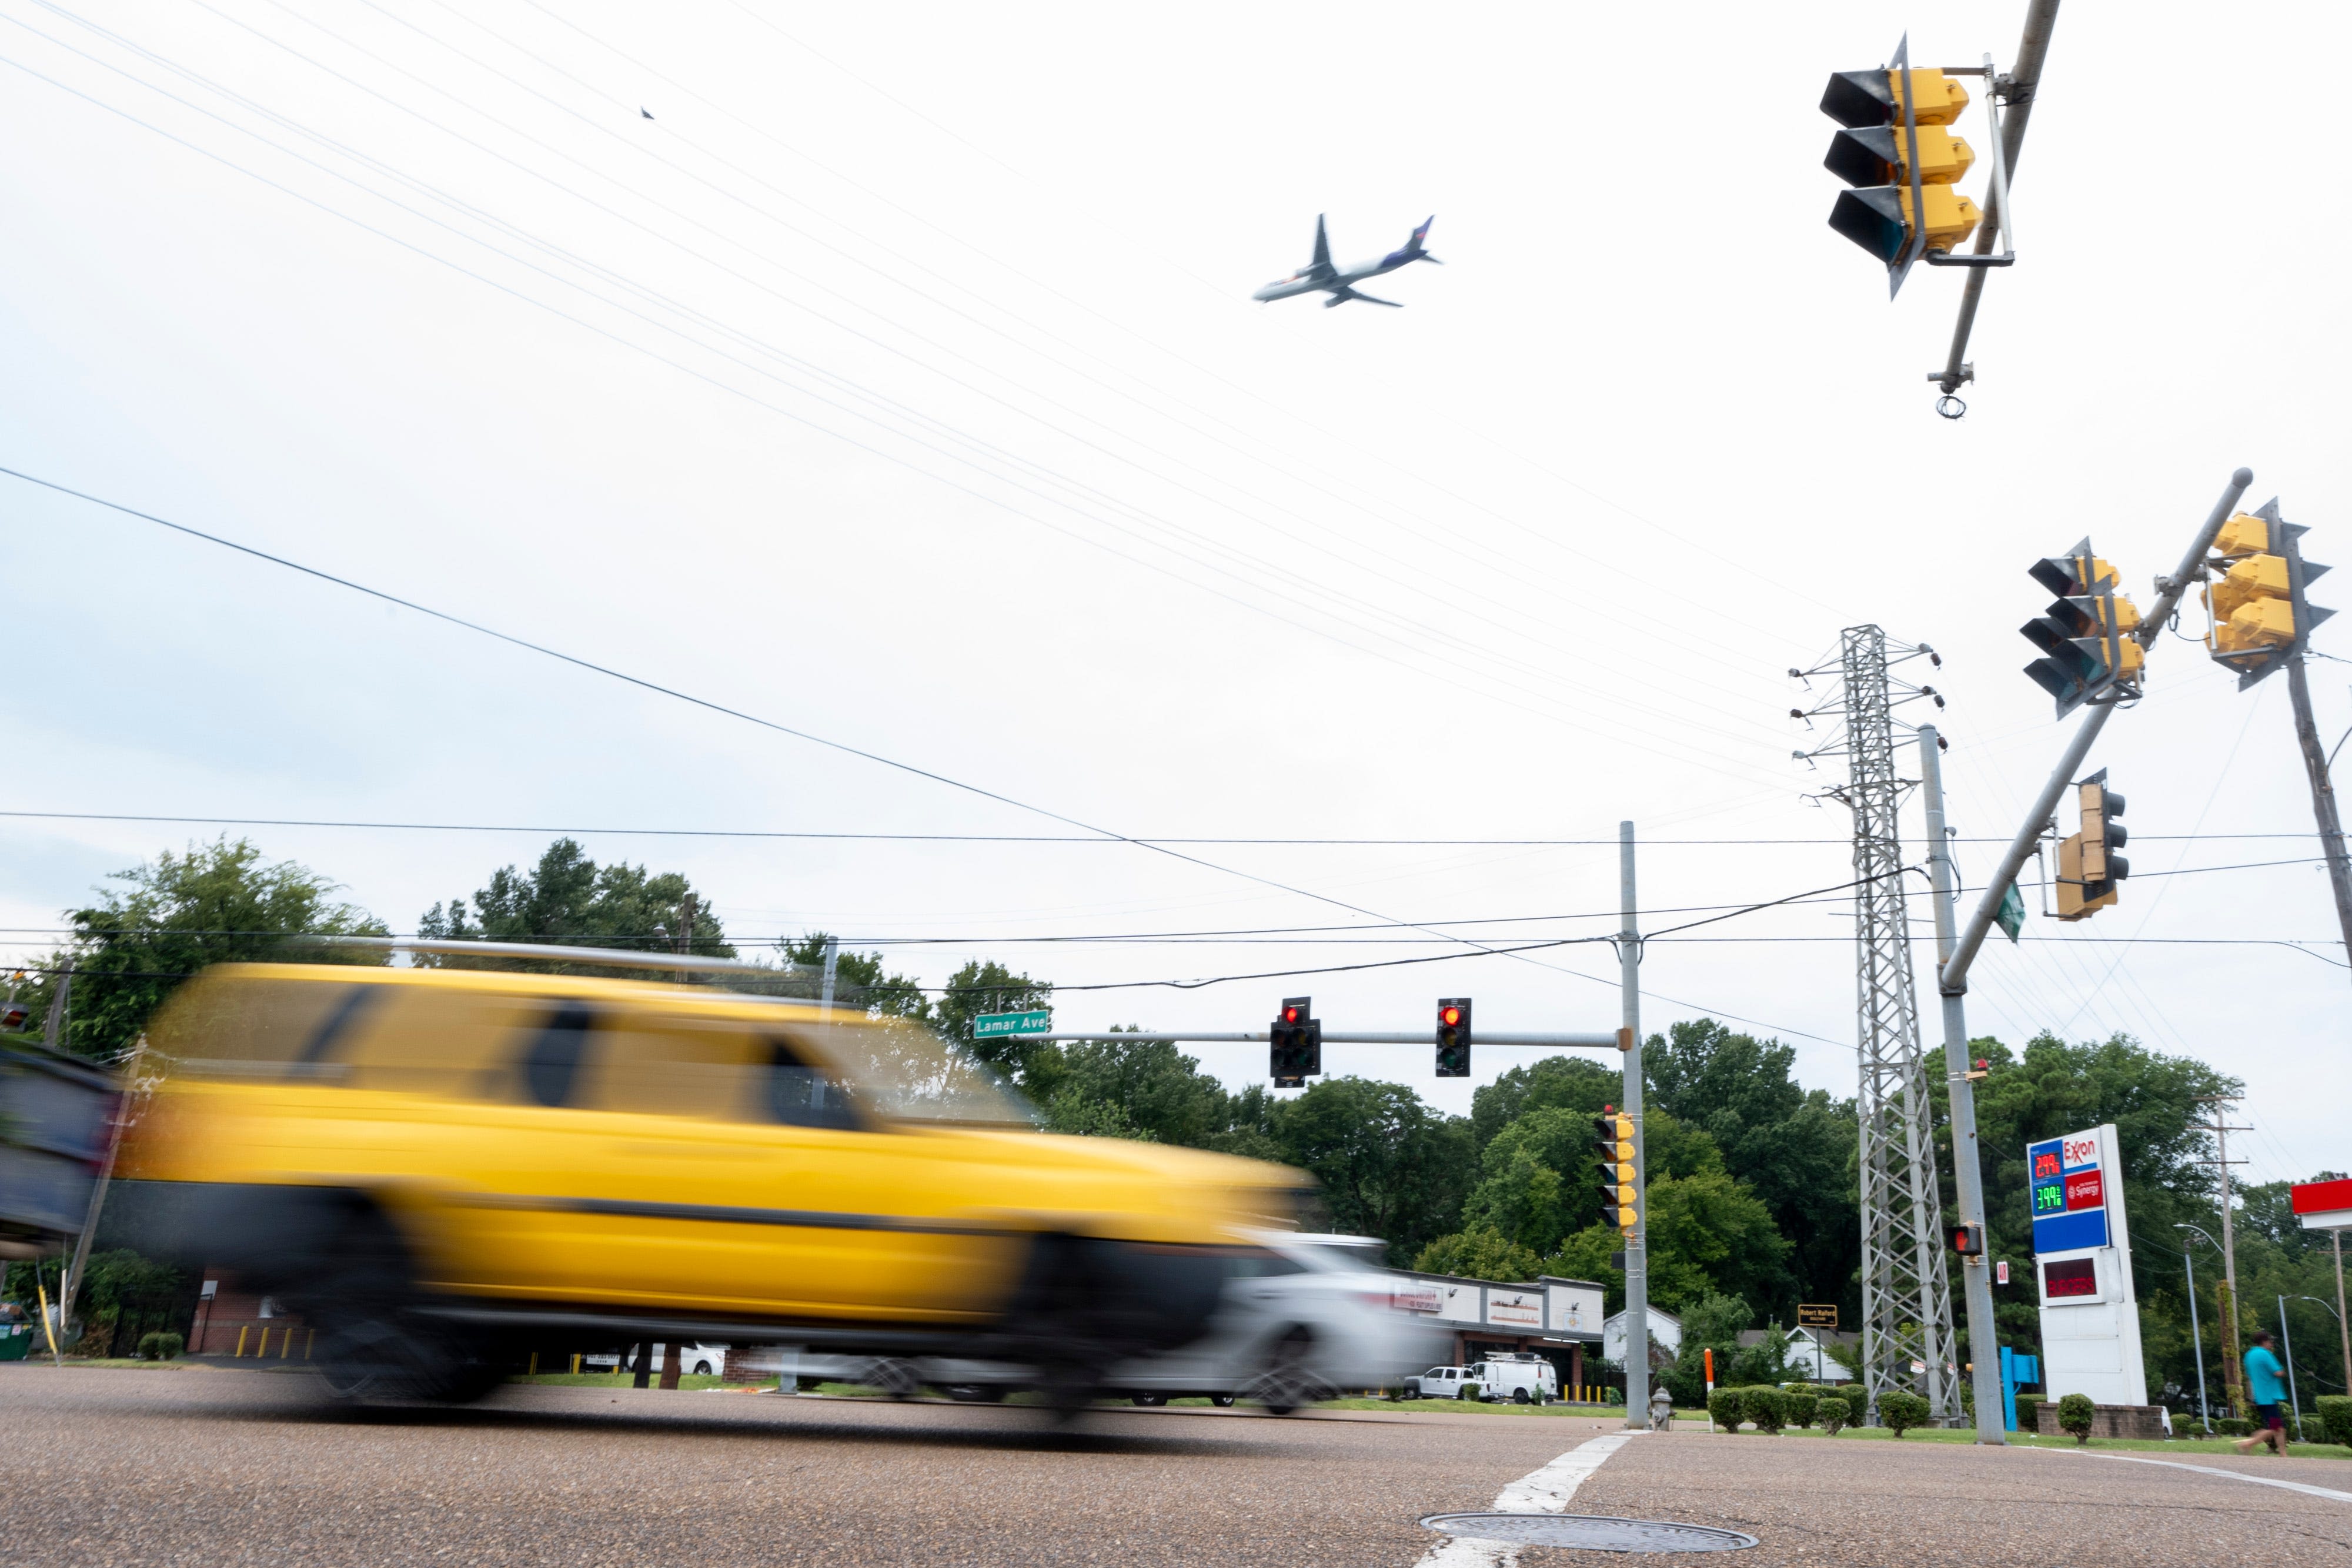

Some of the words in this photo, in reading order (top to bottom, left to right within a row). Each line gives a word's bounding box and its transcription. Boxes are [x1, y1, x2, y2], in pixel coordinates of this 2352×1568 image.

[977, 1021, 1016, 1032] Lamar
[1021, 1017, 1045, 1029] Ave
[2064, 1141, 2095, 1163] Exxon
[2076, 1185, 2099, 1198] Synergy
